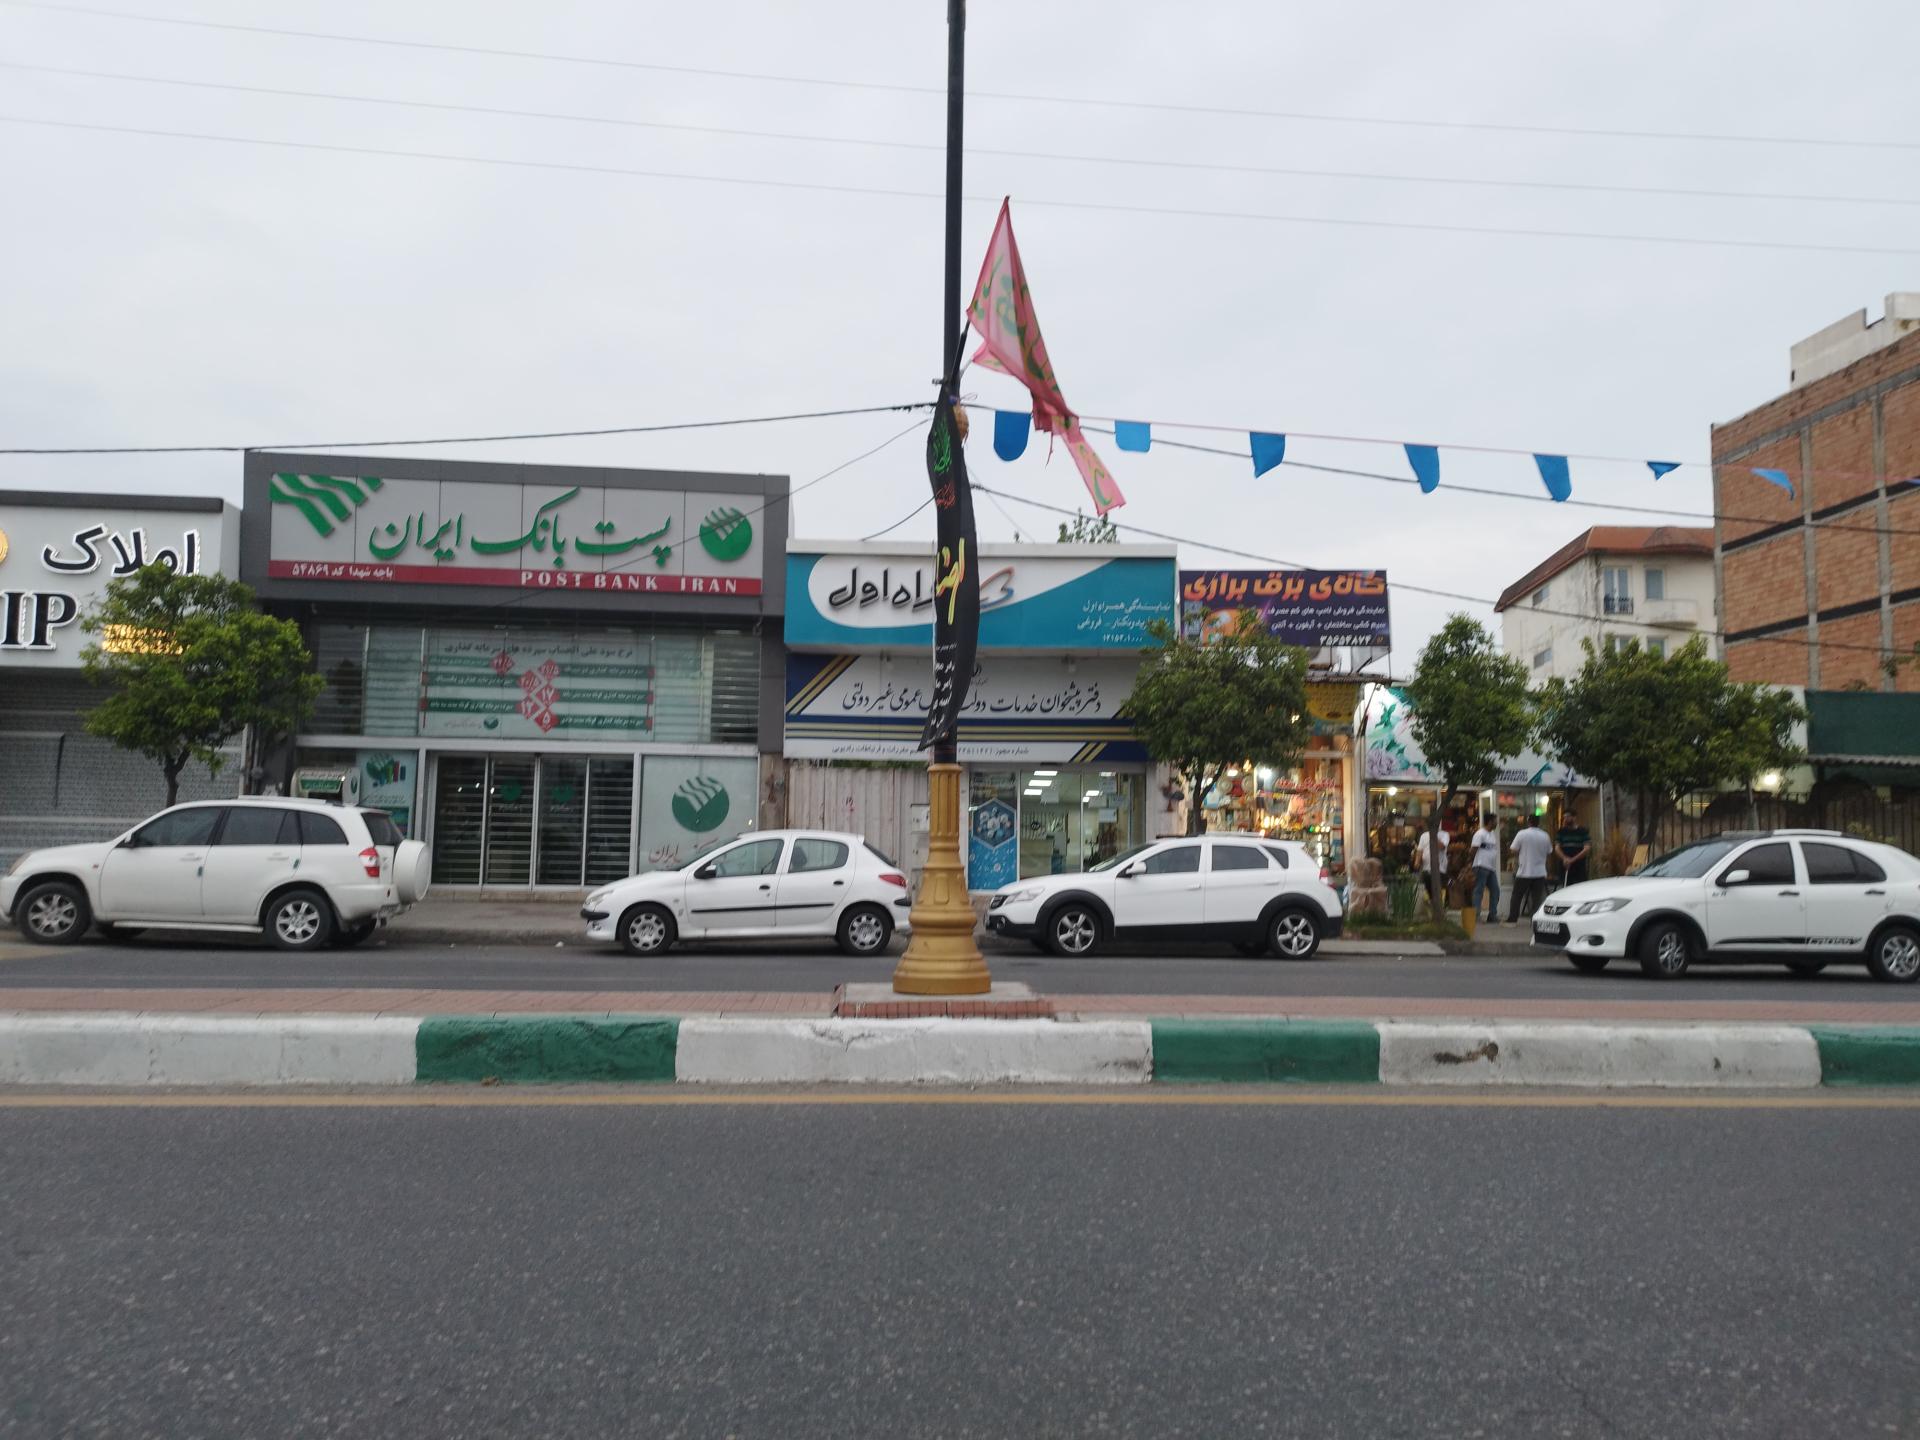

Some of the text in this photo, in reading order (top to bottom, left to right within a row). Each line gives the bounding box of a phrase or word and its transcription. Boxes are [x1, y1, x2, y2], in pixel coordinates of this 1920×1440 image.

[369, 486, 672, 568] پست بانک ایران
[41, 523, 200, 577] املاک
[521, 571, 738, 593] POST BANK IRAN
[828, 565, 889, 609] اول
[1183, 571, 1386, 601] کالای برق براری
[1083, 599, 1099, 613] اول
[1124, 598, 1171, 614] نمایندگی
[842, 680, 869, 710] دولتی
[890, 688, 922, 712] عمومی
[989, 693, 1038, 713] خدمات
[1040, 680, 1081, 714] پیشخوان
[1075, 682, 1102, 716] دفتر
